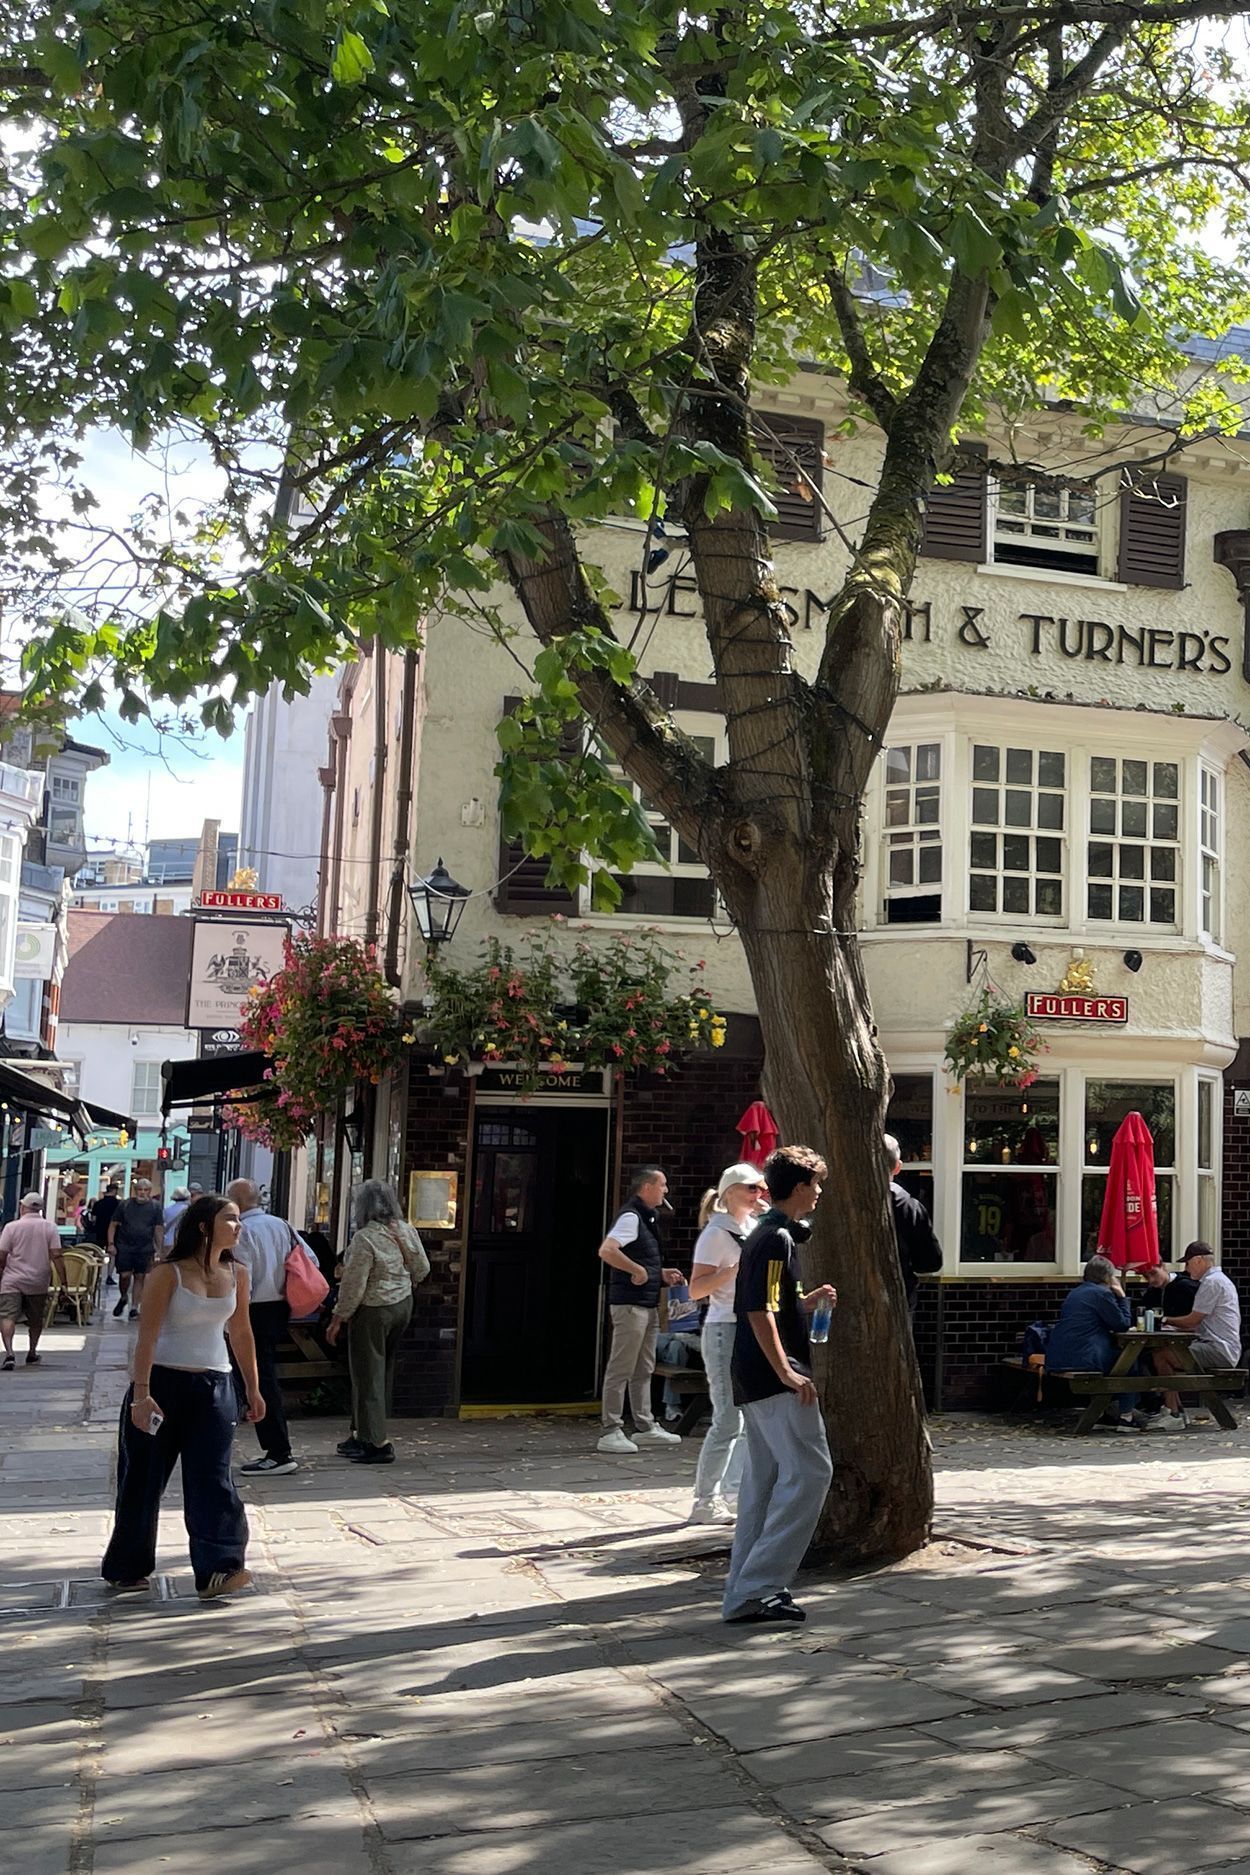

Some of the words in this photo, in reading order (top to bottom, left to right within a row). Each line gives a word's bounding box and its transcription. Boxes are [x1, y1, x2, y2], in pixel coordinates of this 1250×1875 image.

[779, 586, 932, 642] SMH
[959, 605, 991, 648] &
[1018, 613, 1232, 675] TURNER'S
[205, 892, 277, 909] FULLER'S
[1033, 996, 1121, 1019] FULLER'S
